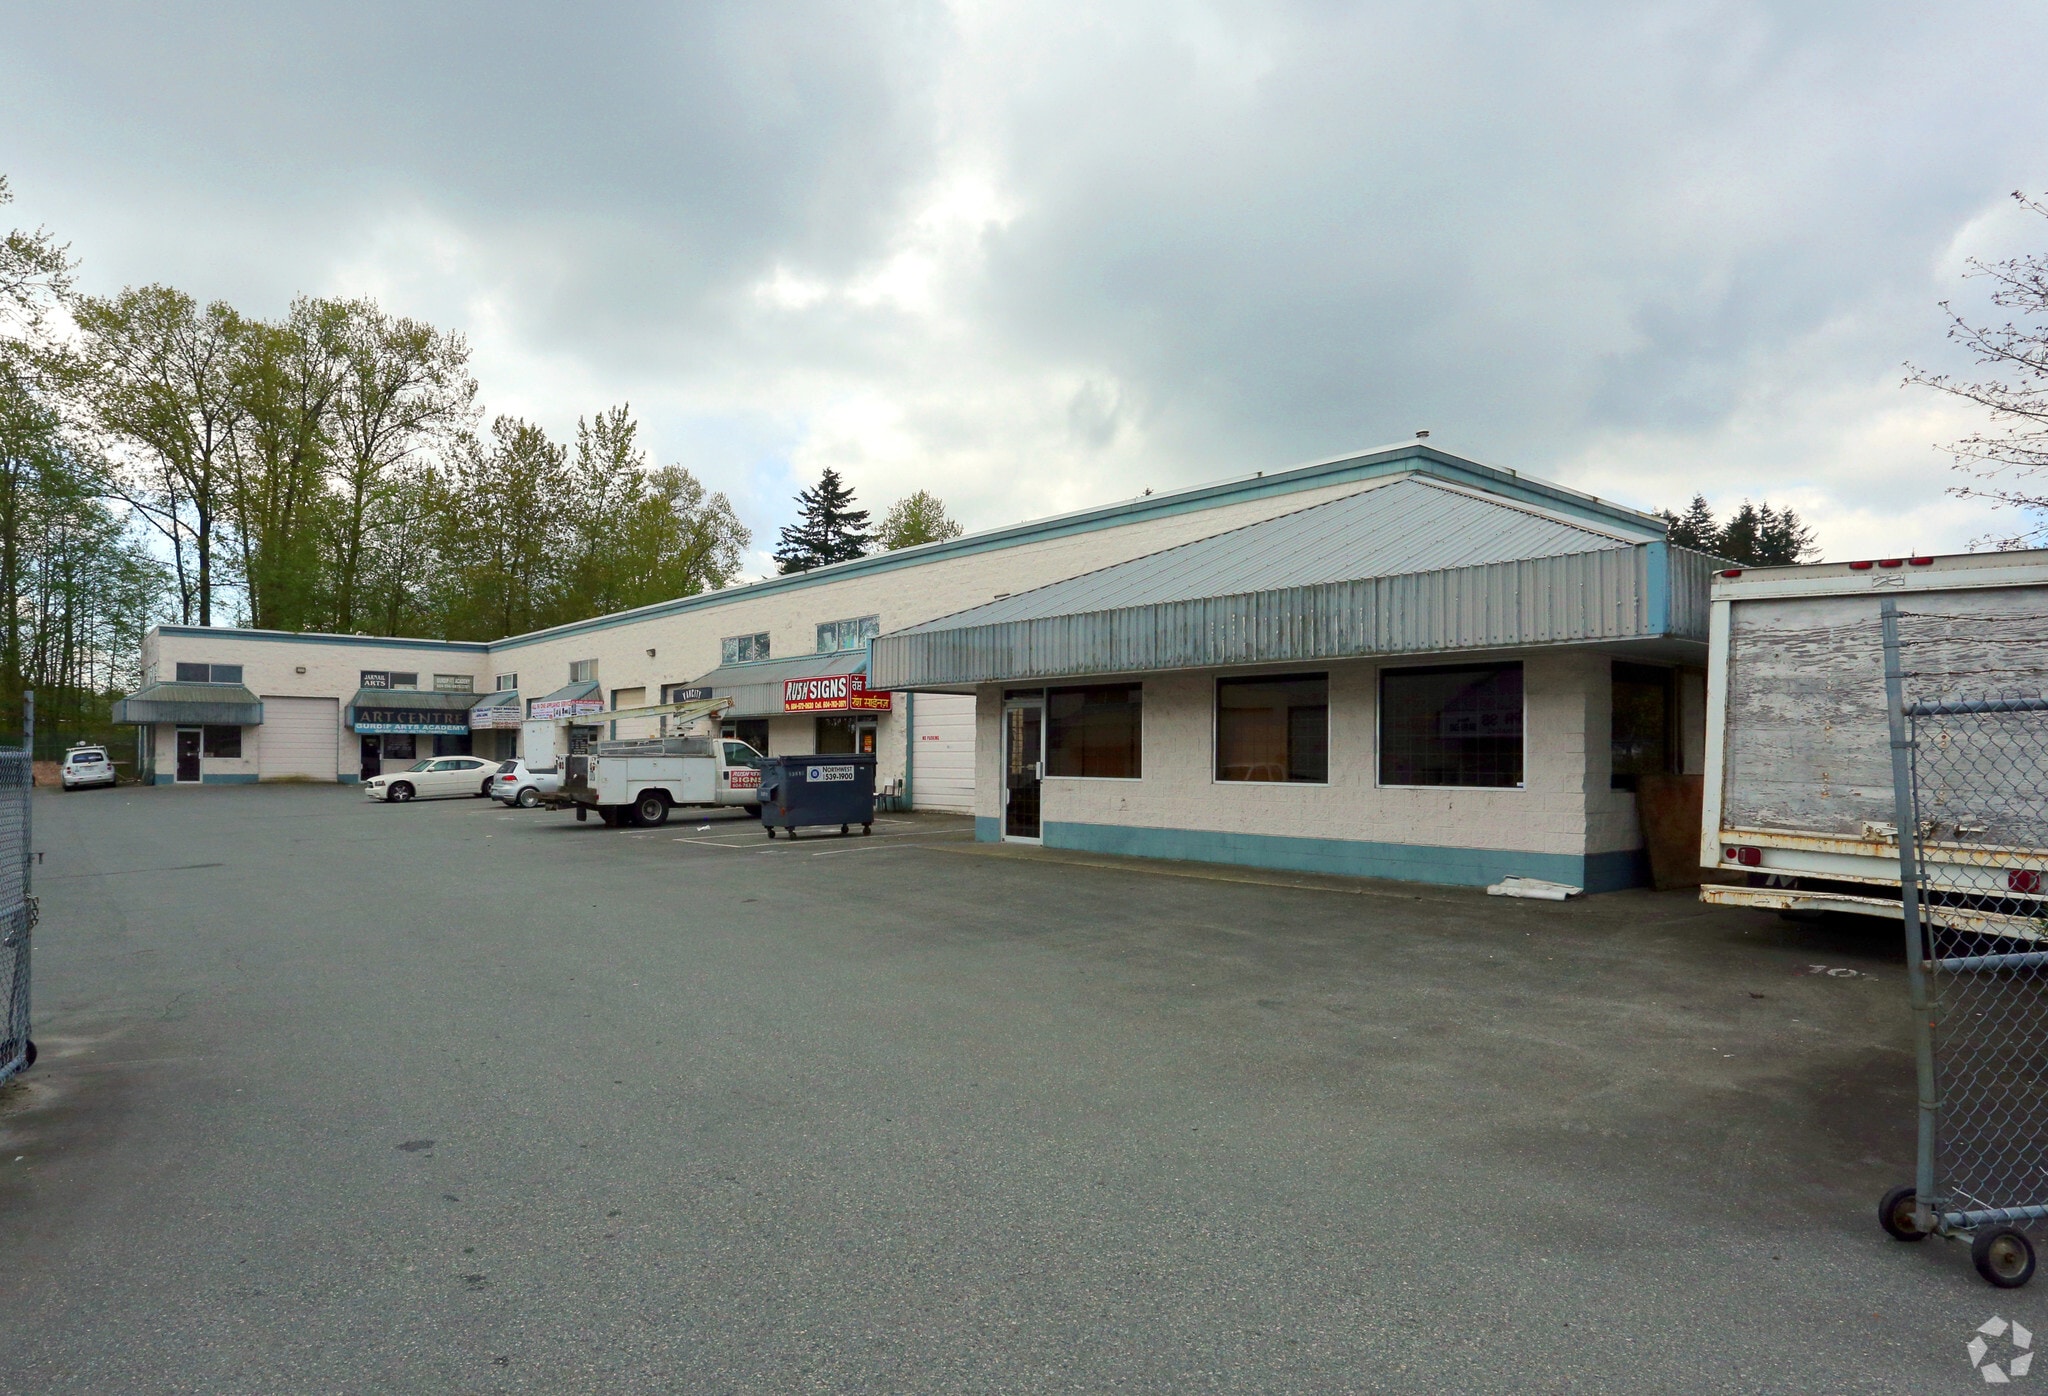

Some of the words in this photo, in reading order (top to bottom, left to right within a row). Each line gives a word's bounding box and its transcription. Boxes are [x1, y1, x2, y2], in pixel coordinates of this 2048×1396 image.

[786, 682, 809, 701] RUSH
[809, 677, 847, 699] SIGNS
[361, 711, 394, 722] ART
[397, 712, 463, 724] CENTRE
